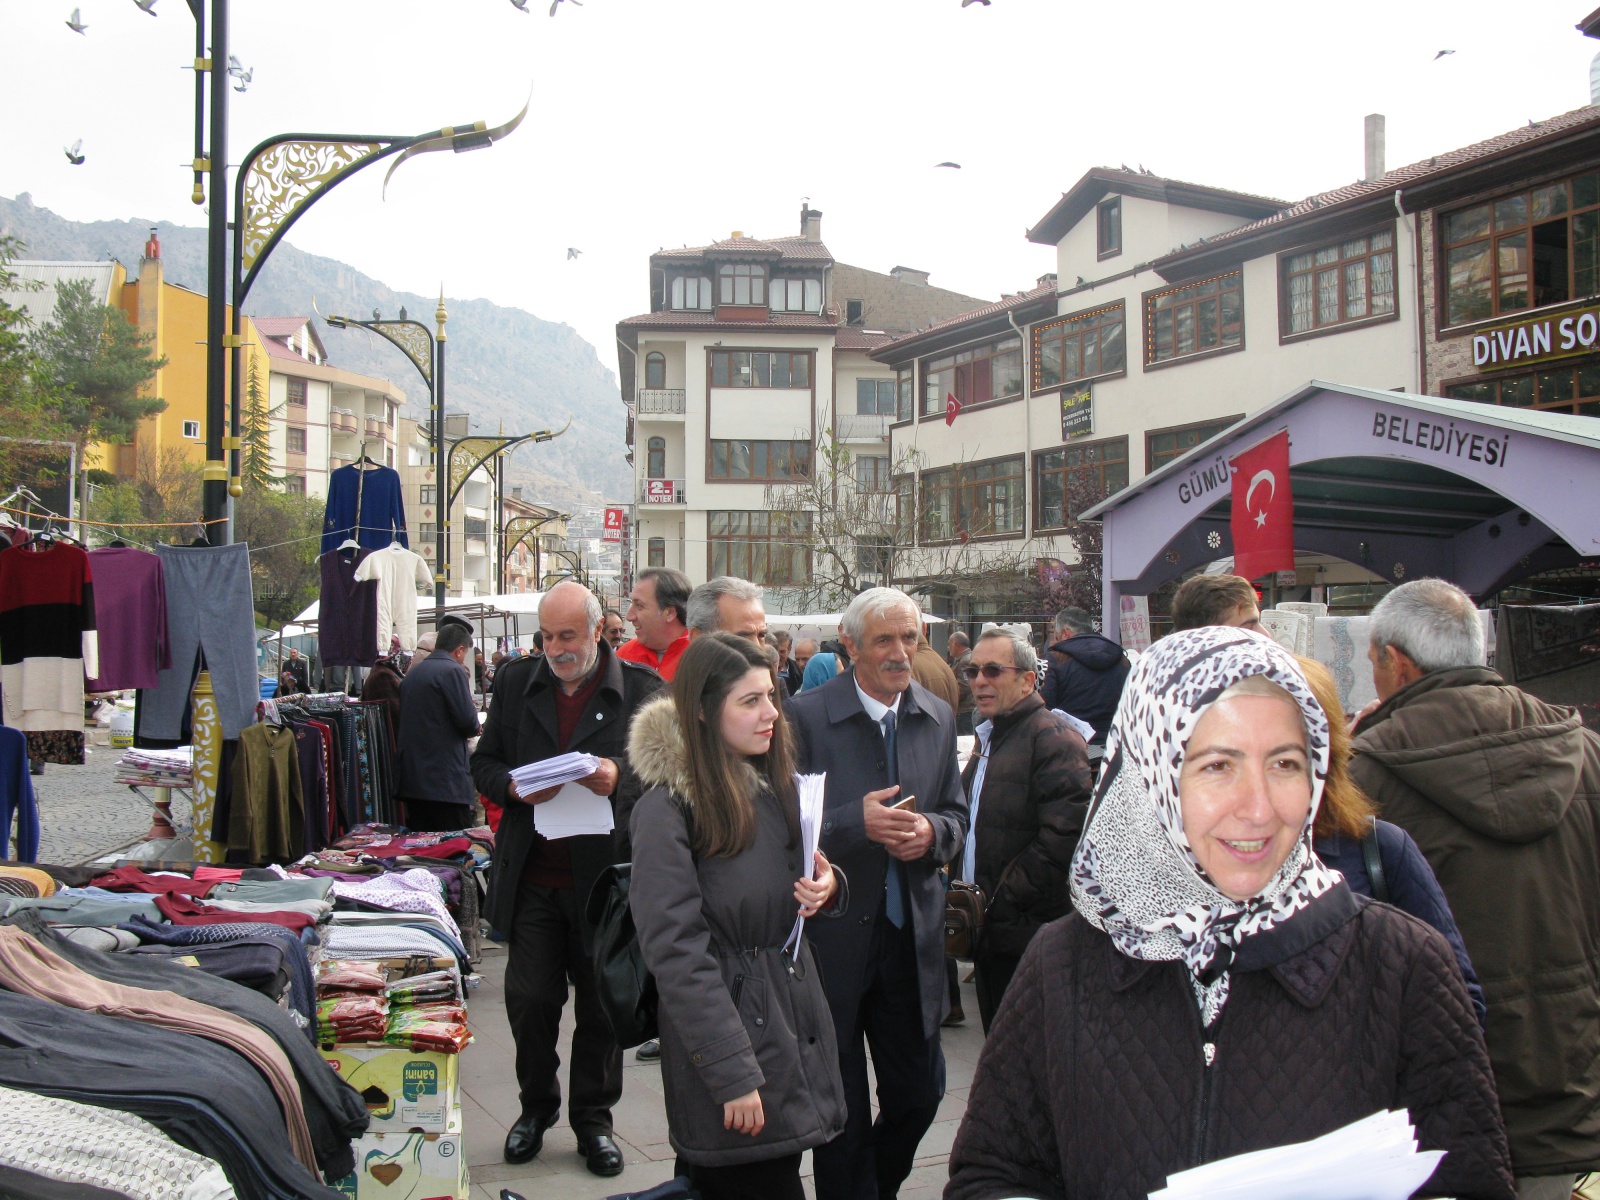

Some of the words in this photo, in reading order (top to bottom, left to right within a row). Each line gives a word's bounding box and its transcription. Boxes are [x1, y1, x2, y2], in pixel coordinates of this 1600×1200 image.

[1559, 312, 1600, 350] SO
[1372, 411, 1509, 468] BELEDİYESİ
[651, 481, 671, 494] 2.
[648, 495, 672, 503] NOTER
[608, 511, 619, 526] 2.
[603, 528, 621, 539] NOTER
[405, 1069, 435, 1080] Banini
